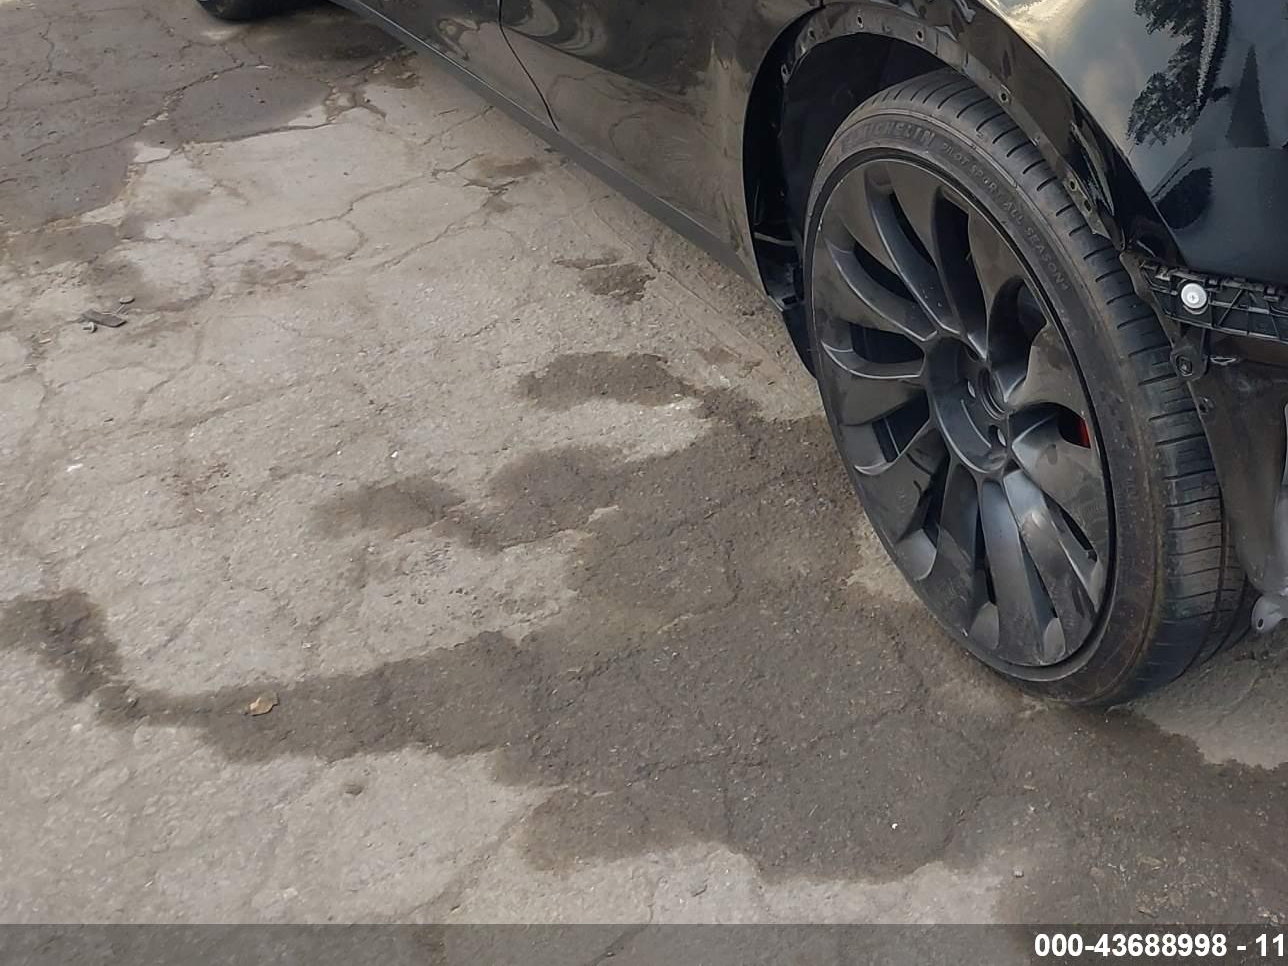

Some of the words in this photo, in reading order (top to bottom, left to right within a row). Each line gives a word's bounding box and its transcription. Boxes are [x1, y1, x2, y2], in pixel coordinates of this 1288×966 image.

[943, 142, 969, 166] PILOT
[1002, 201, 1025, 226] ALL
[1024, 226, 1065, 284] SEASON
